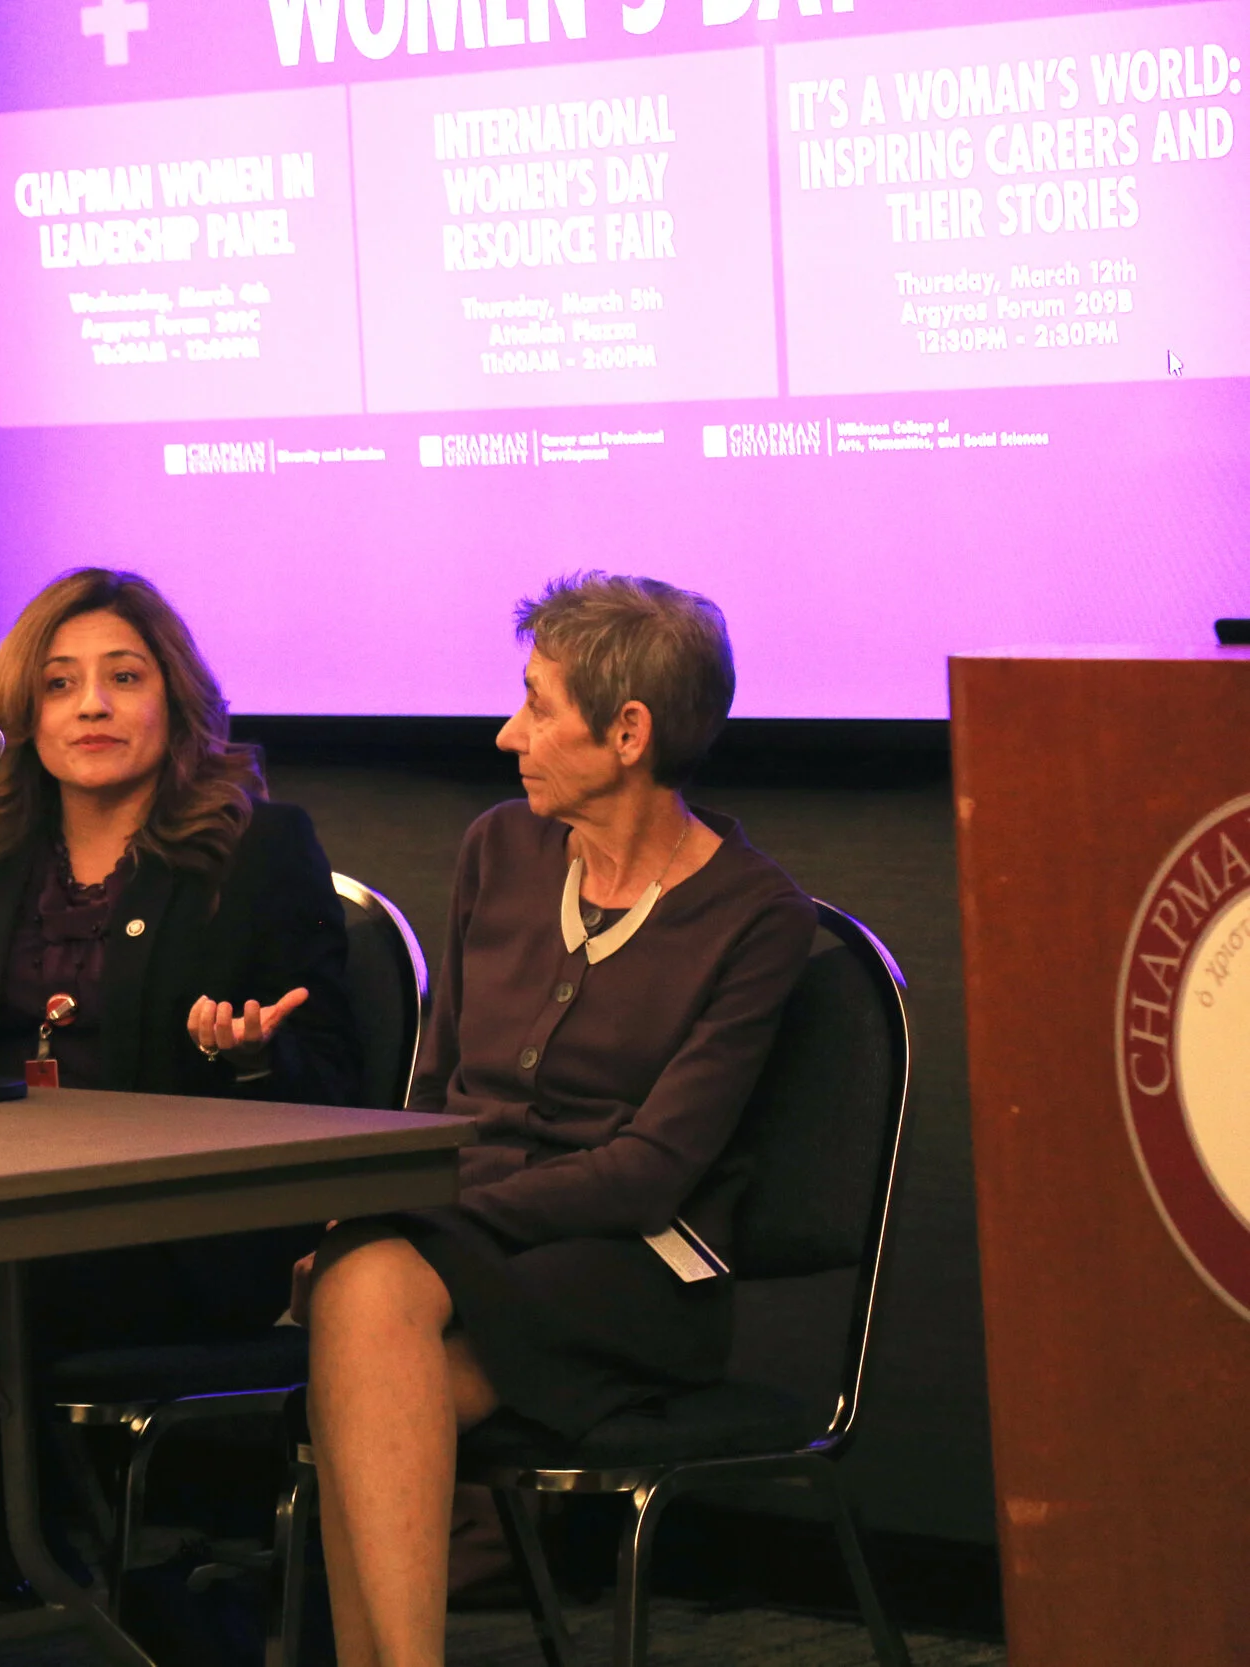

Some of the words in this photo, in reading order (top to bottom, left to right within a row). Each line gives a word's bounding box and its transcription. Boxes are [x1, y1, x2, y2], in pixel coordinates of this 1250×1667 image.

[788, 78, 849, 131] IT'S
[860, 75, 886, 126] A
[894, 57, 1079, 122] WOMAN'S
[1090, 43, 1241, 106] WORLD:
[434, 94, 676, 160] INTERNATIONAL
[799, 127, 974, 190] INSPIRING
[985, 113, 1140, 175] CAREERS
[1151, 106, 1234, 163] AND
[15, 164, 153, 217] CHAPMAN
[158, 155, 274, 207] WOMEN
[281, 152, 315, 199] IN
[443, 158, 597, 215] WOMEN'S
[606, 152, 669, 204] DAY
[886, 188, 986, 243] THEIR
[996, 175, 1140, 236] STORIES
[39, 215, 199, 269] LEADERSHIP
[206, 209, 296, 259] PANEL
[443, 215, 597, 271] RESOURCE
[606, 210, 677, 261] FAIR
[894, 267, 1000, 296] Thursday,
[1010, 261, 1080, 289] March
[1089, 257, 1137, 284] 12th
[461, 294, 555, 321] Thursday,
[562, 289, 624, 314] March
[630, 286, 664, 311] 5th
[901, 301, 988, 329] Argyros
[997, 295, 1065, 320] Forum
[1075, 289, 1133, 316] 209B
[480, 350, 561, 374] 11:00AM
[582, 344, 657, 370] 2:00PM
[917, 326, 1008, 354] 12:30PM
[1034, 320, 1119, 348] 2:30PM
[187, 441, 266, 460] CHAPMAN
[443, 431, 528, 453] CHAPMAN
[729, 420, 821, 443] CHAPMAN
[730, 438, 821, 457] UNIVERSITY
[1129, 818, 1250, 1096] CHAPMA
